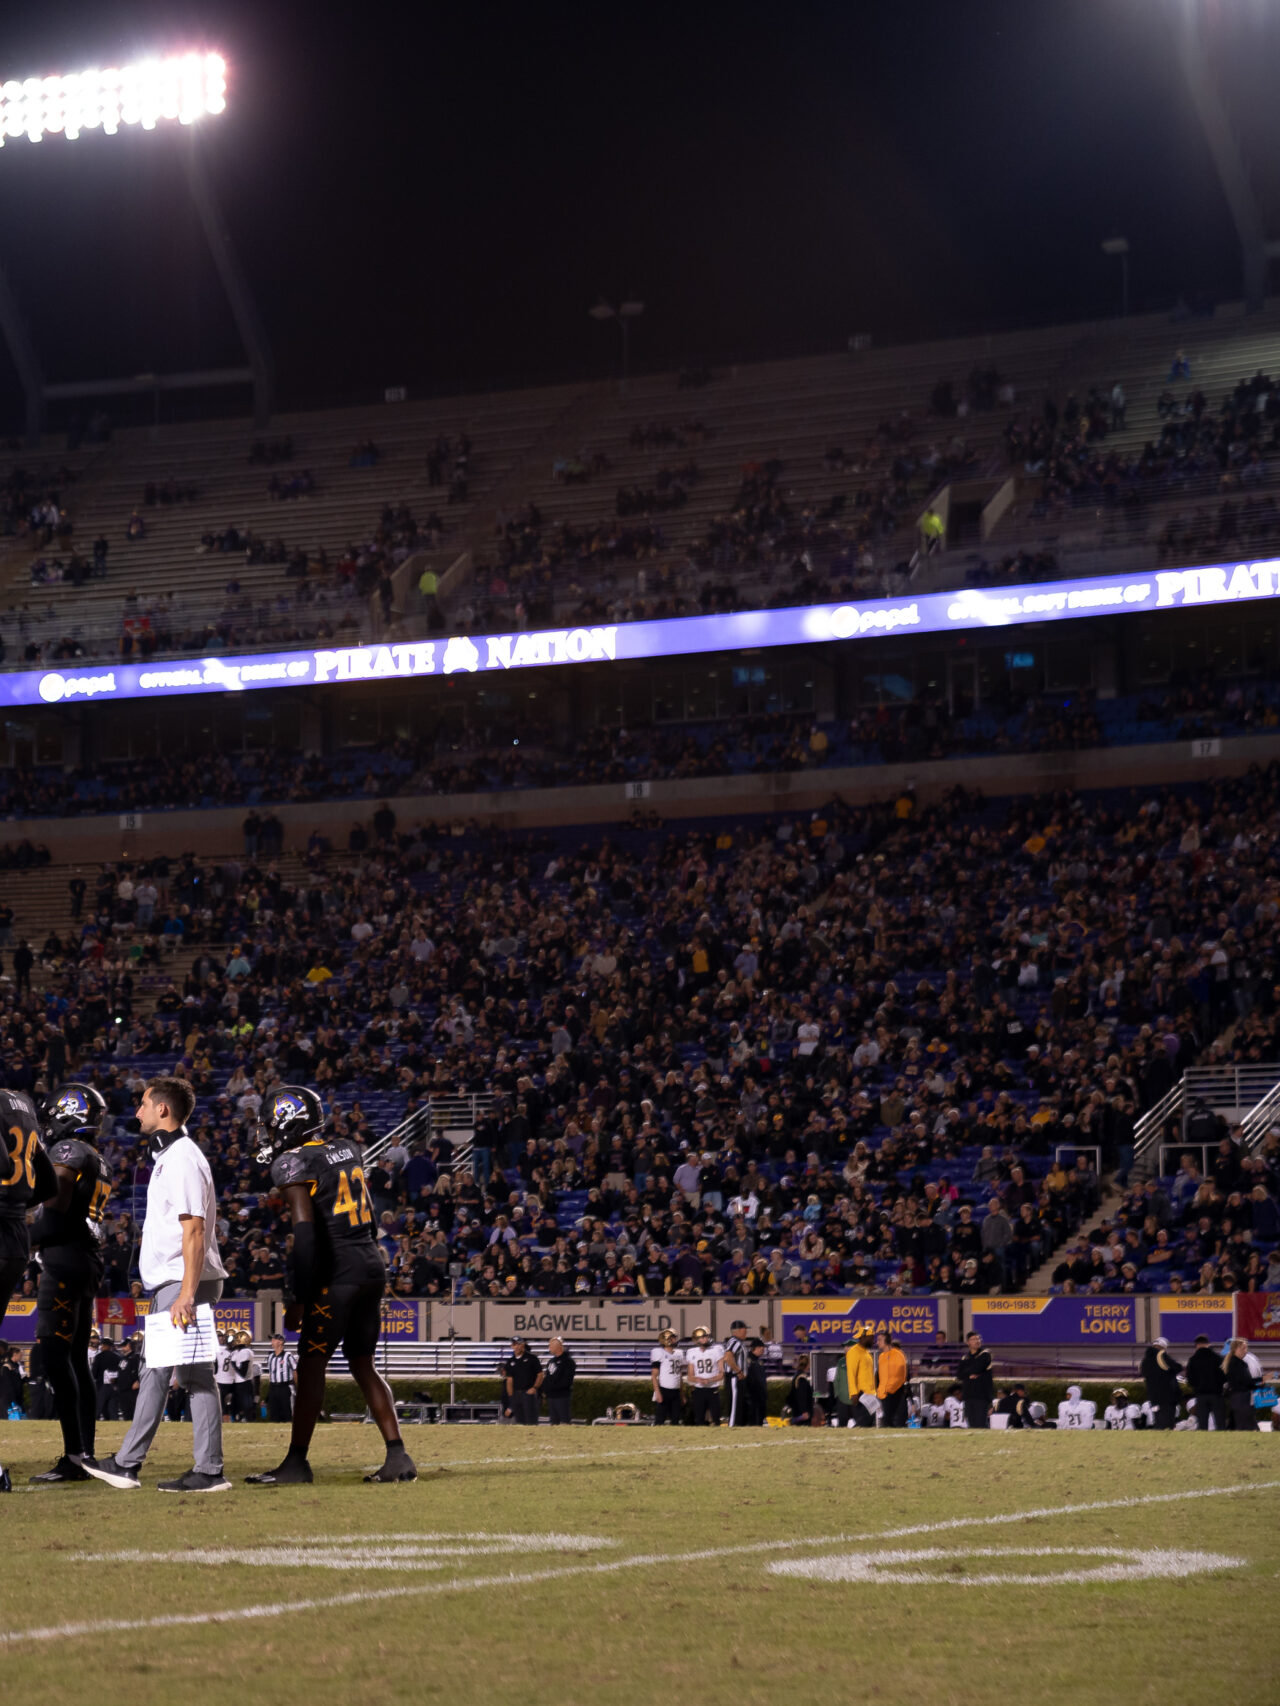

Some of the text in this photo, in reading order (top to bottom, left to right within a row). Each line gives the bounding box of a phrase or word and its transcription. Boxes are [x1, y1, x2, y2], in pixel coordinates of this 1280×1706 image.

[1155, 561, 1280, 607] PIRAT
[313, 627, 617, 681] PIRATE NATION
[332, 1166, 372, 1227] 42
[812, 1301, 825, 1310] 20
[987, 1300, 1036, 1310] 1980-1983
[1084, 1305, 1130, 1317] TERRY
[1177, 1299, 1227, 1309] 1981-1982
[892, 1306, 934, 1317] BOWL
[514, 1314, 672, 1331] BAGWELL FIELD
[809, 1319, 934, 1333] APPEARANCES
[1081, 1319, 1131, 1333] LONG
[697, 1358, 713, 1374] 98
